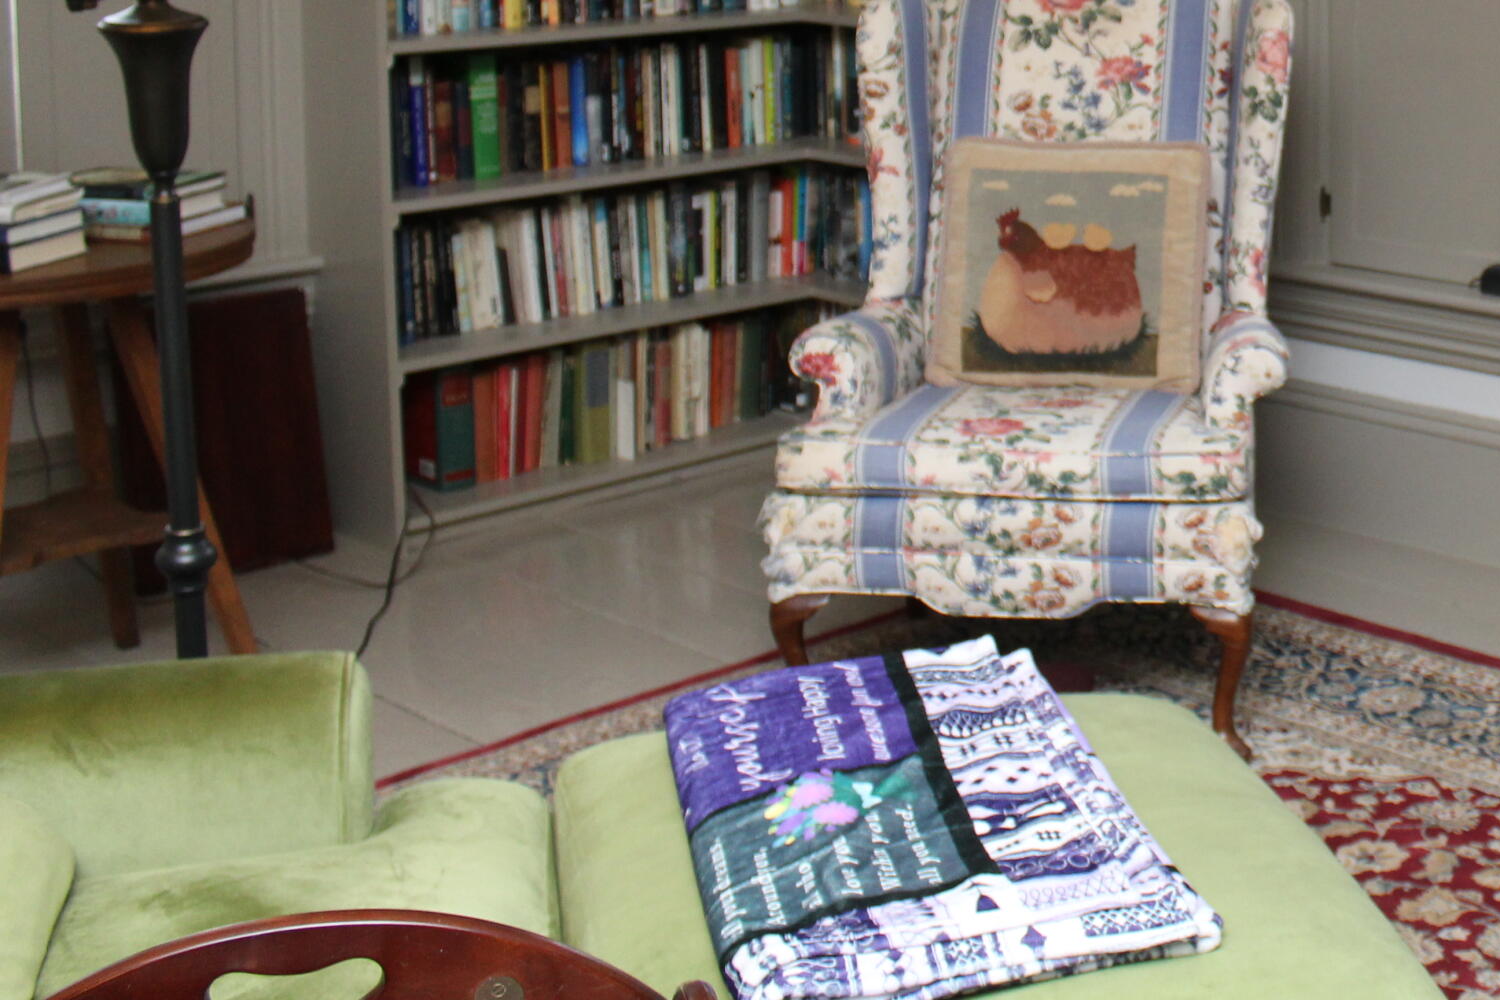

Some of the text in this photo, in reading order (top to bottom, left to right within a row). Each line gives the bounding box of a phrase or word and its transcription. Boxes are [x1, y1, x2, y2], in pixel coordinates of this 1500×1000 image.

[798, 676, 831, 719] Happy
[705, 684, 793, 791] yourself
[911, 841, 941, 866] you
